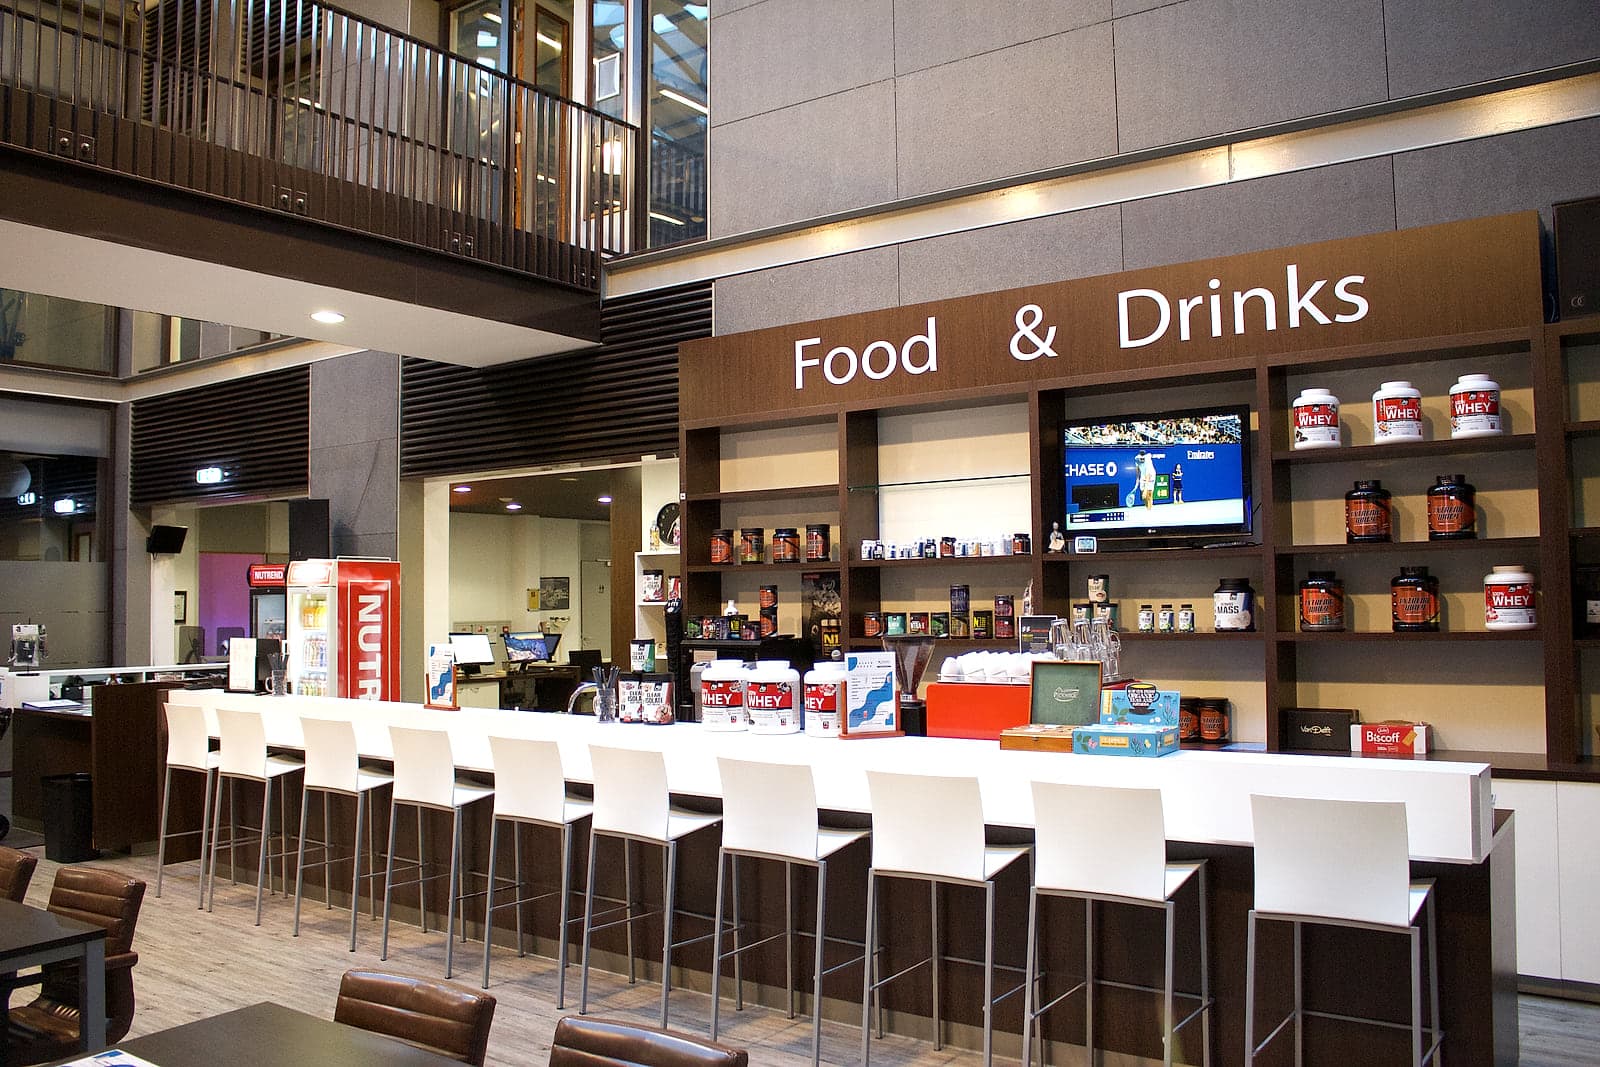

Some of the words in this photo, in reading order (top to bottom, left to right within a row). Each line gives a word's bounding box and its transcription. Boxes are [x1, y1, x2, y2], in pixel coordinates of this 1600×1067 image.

[794, 317, 938, 390] Food
[1009, 304, 1058, 361] &
[1117, 263, 1369, 349] Drinks
[1386, 408, 1419, 419] WHEY
[1455, 402, 1491, 415] WHEY
[1299, 414, 1332, 426] WHEY
[254, 571, 284, 580] NUTREND
[1492, 595, 1530, 606] WHEY
[1217, 605, 1240, 614] MASS
[748, 695, 782, 707] WHEY
[1366, 730, 1400, 743] Biscoff
